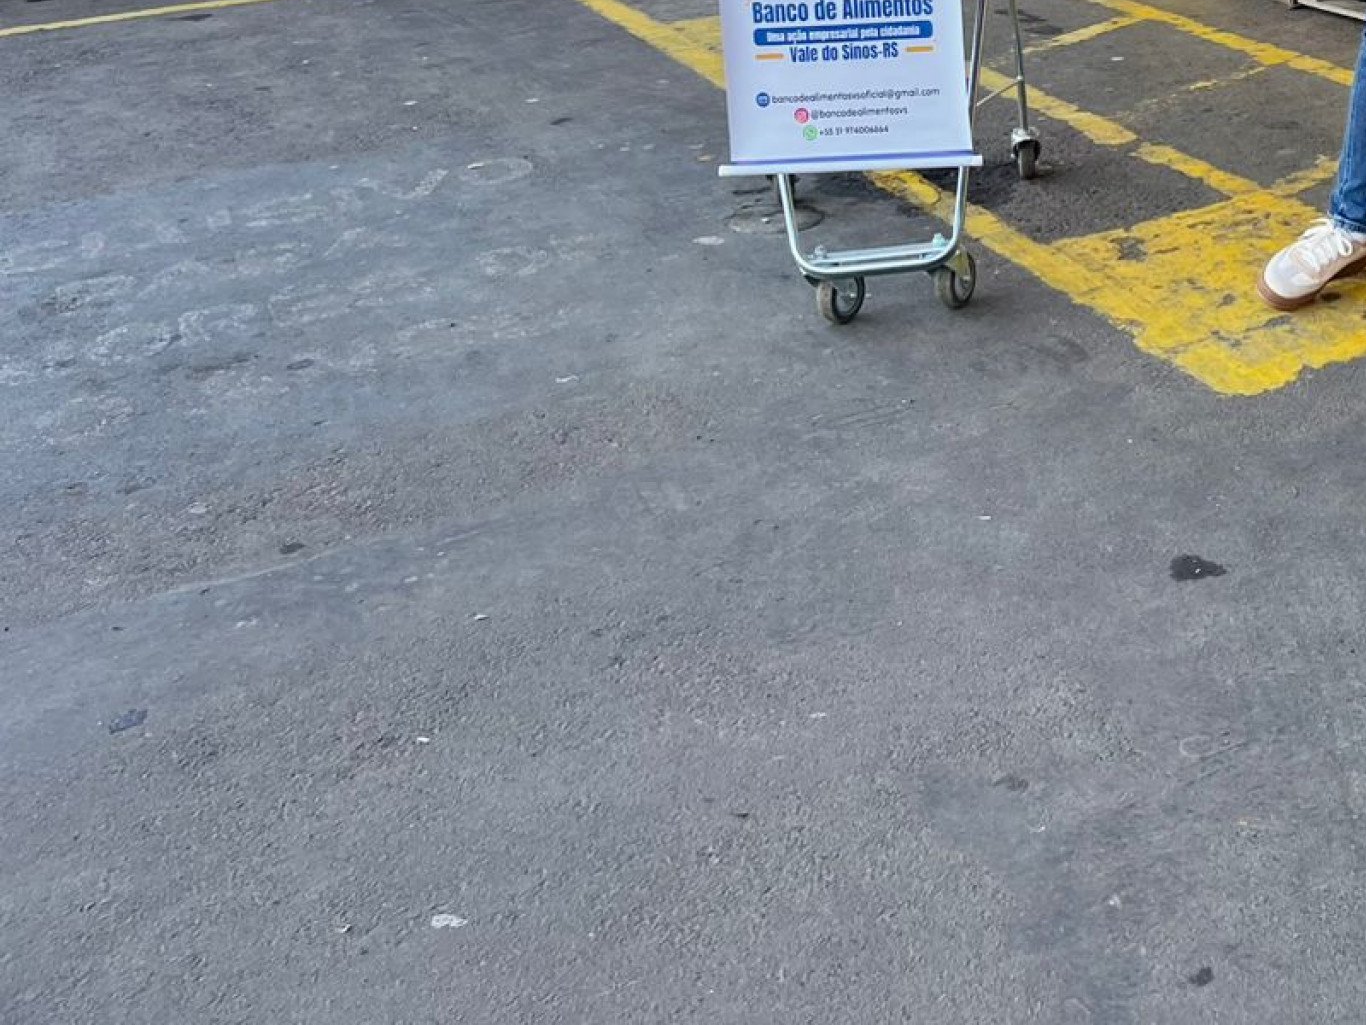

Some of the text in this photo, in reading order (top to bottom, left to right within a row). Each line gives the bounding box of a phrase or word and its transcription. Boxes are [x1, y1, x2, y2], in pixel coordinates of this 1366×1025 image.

[752, 1, 809, 24] Banco
[789, 42, 899, 63] Vale do Sinos-RS
